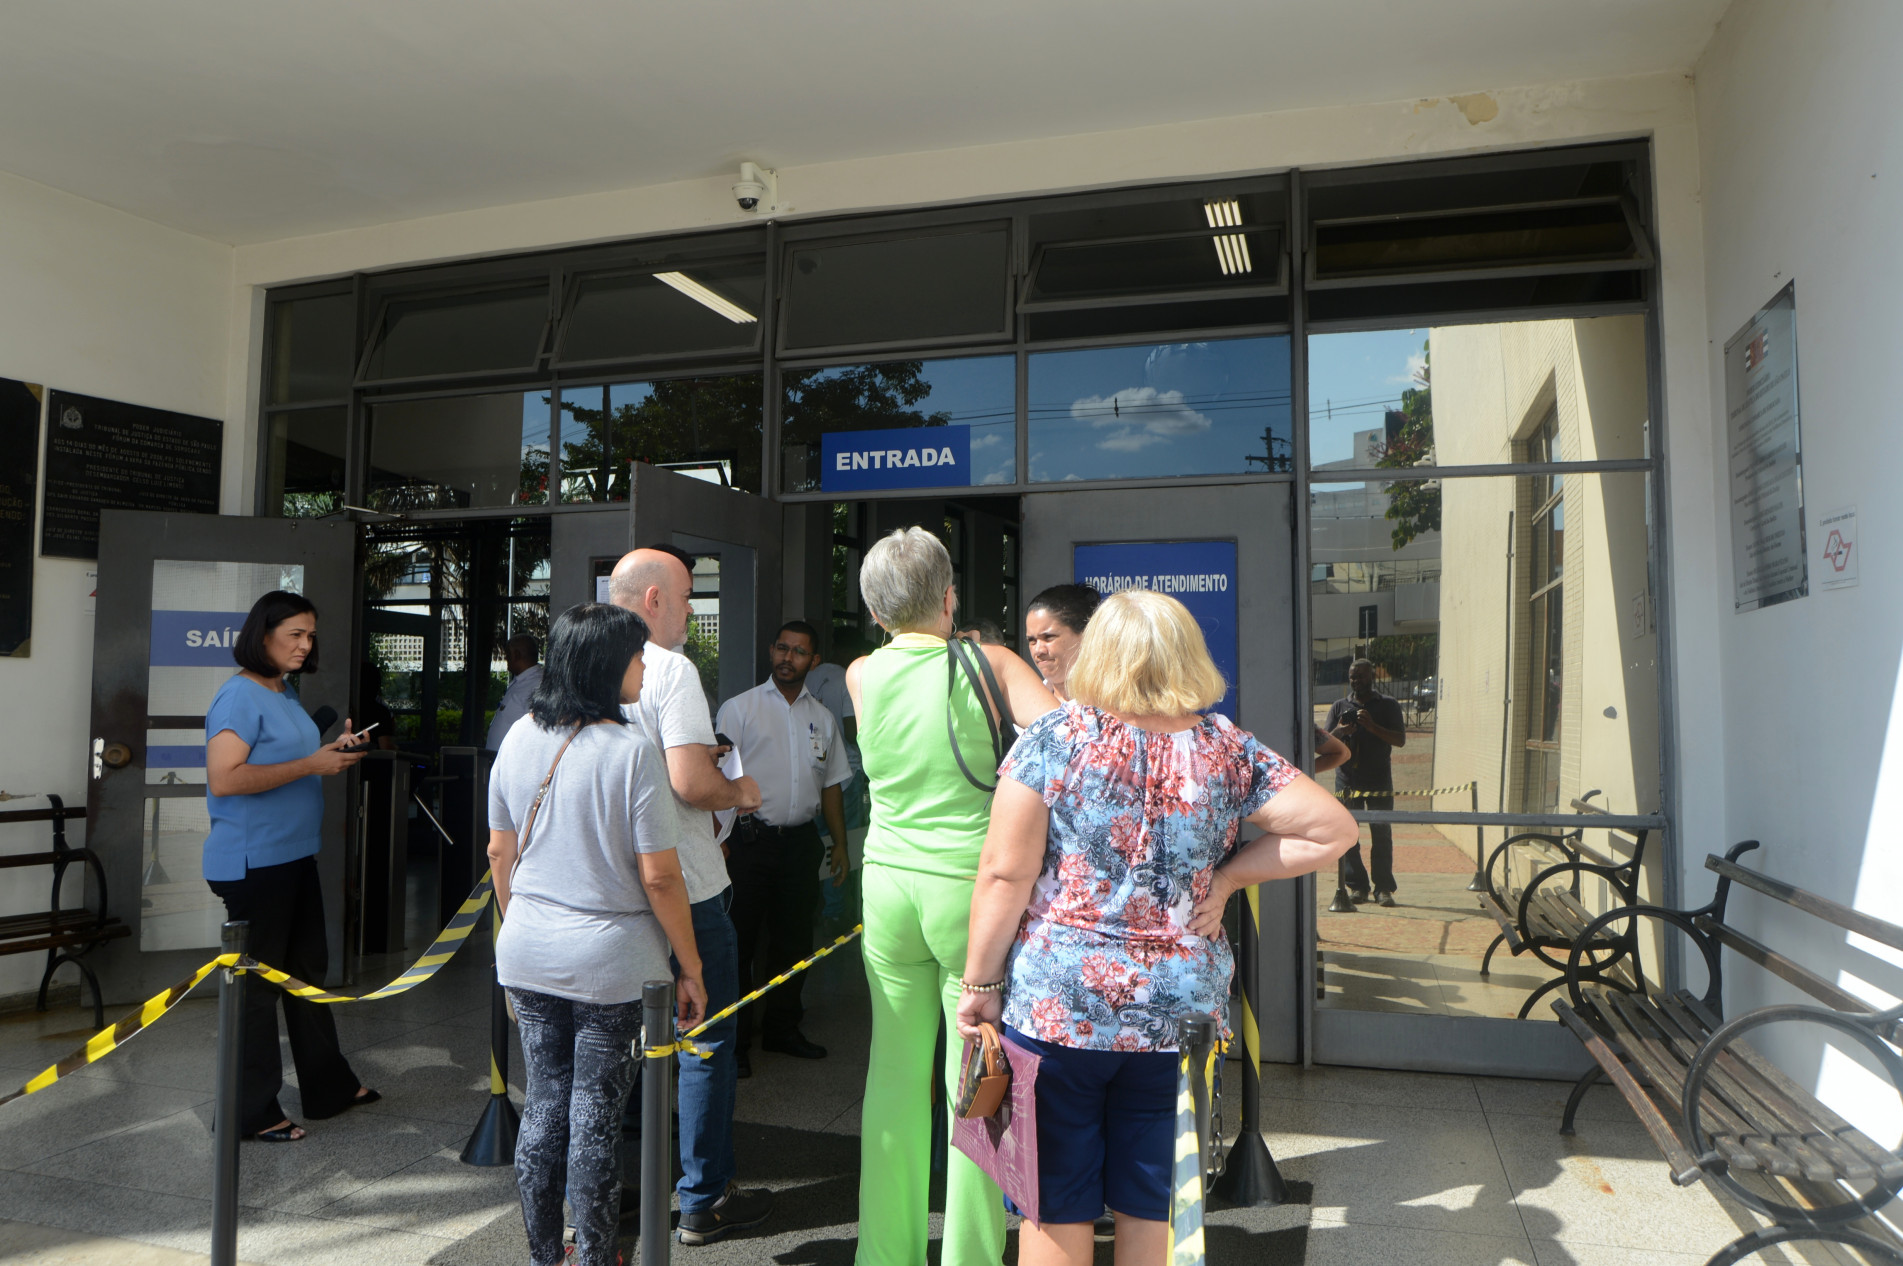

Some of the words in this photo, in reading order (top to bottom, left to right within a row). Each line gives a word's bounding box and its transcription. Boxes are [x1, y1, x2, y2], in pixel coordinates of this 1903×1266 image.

[836, 447, 955, 471] ENTRADA
[1135, 575, 1149, 592] DE
[1151, 574, 1228, 593] ATENDIMENTO
